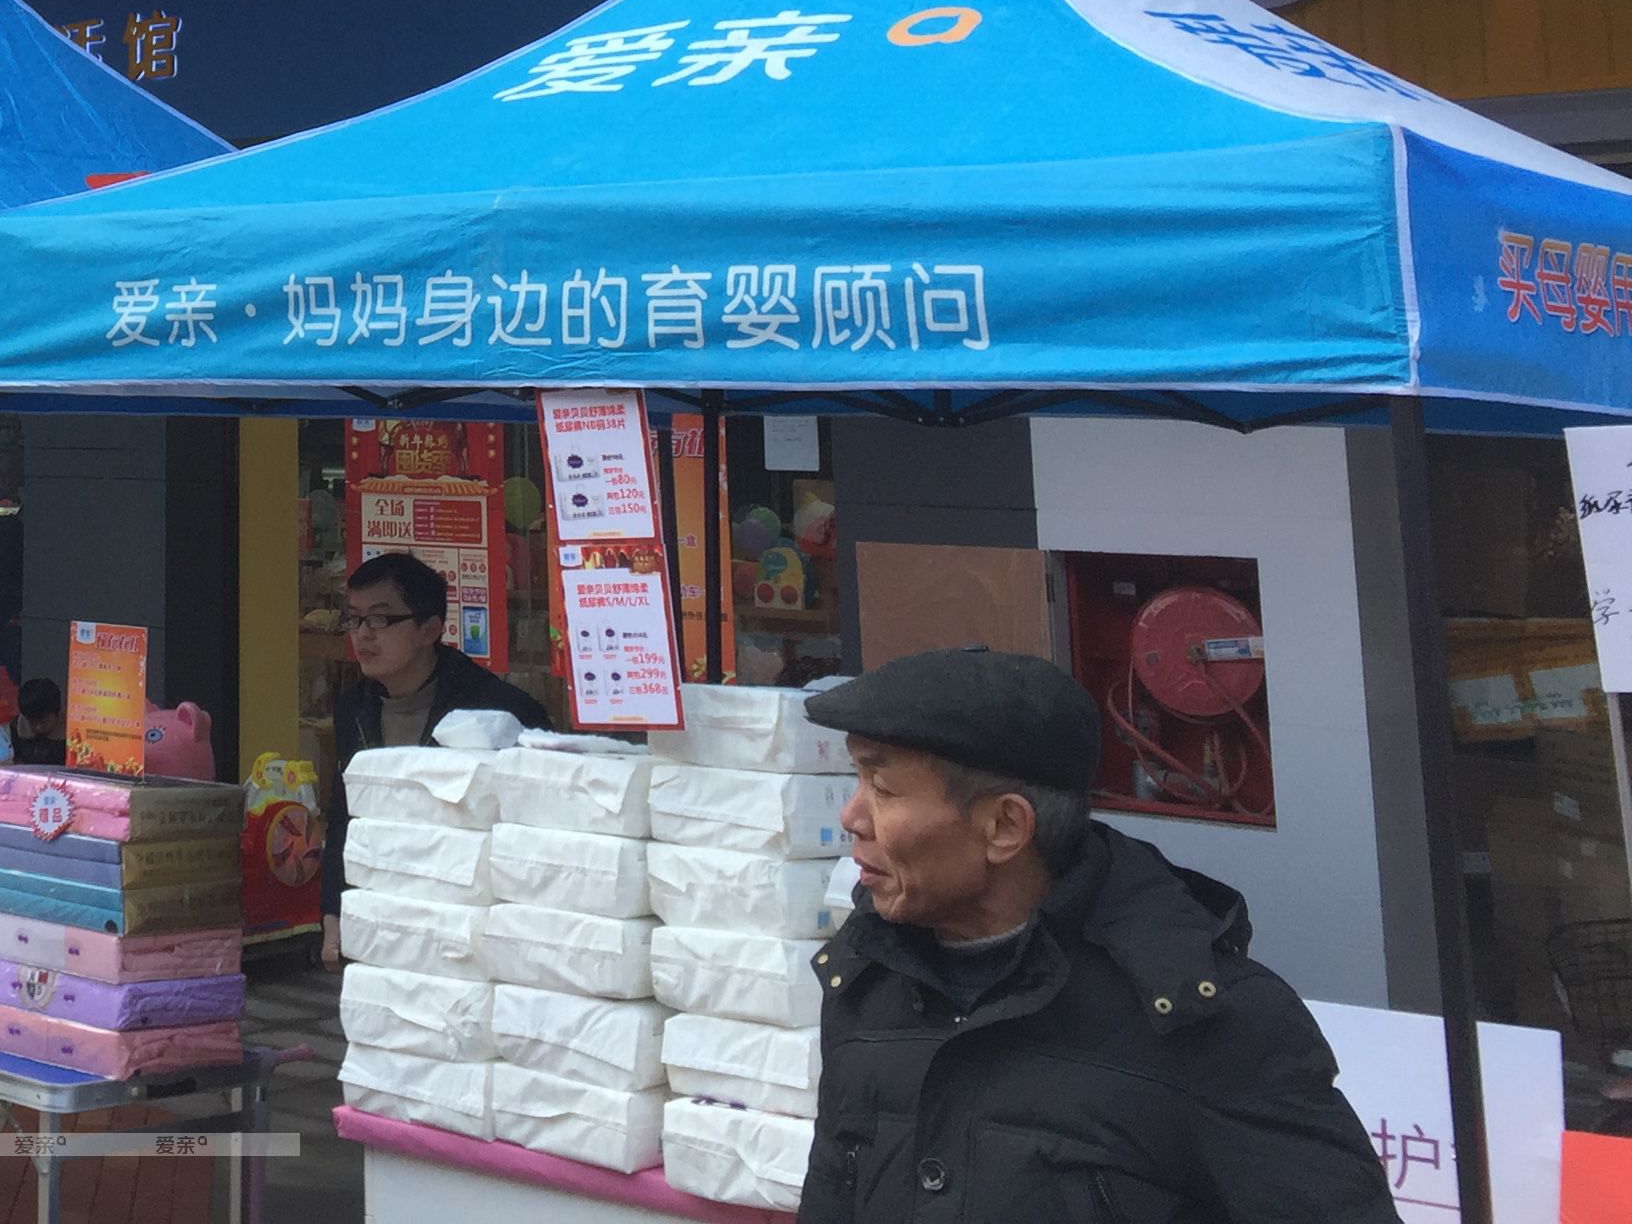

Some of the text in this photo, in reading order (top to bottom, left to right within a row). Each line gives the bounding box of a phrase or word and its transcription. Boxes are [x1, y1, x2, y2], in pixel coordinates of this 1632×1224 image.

[494, 8, 854, 103] 爱亲
[374, 498, 406, 518] 全场
[366, 520, 412, 539] 满即送
